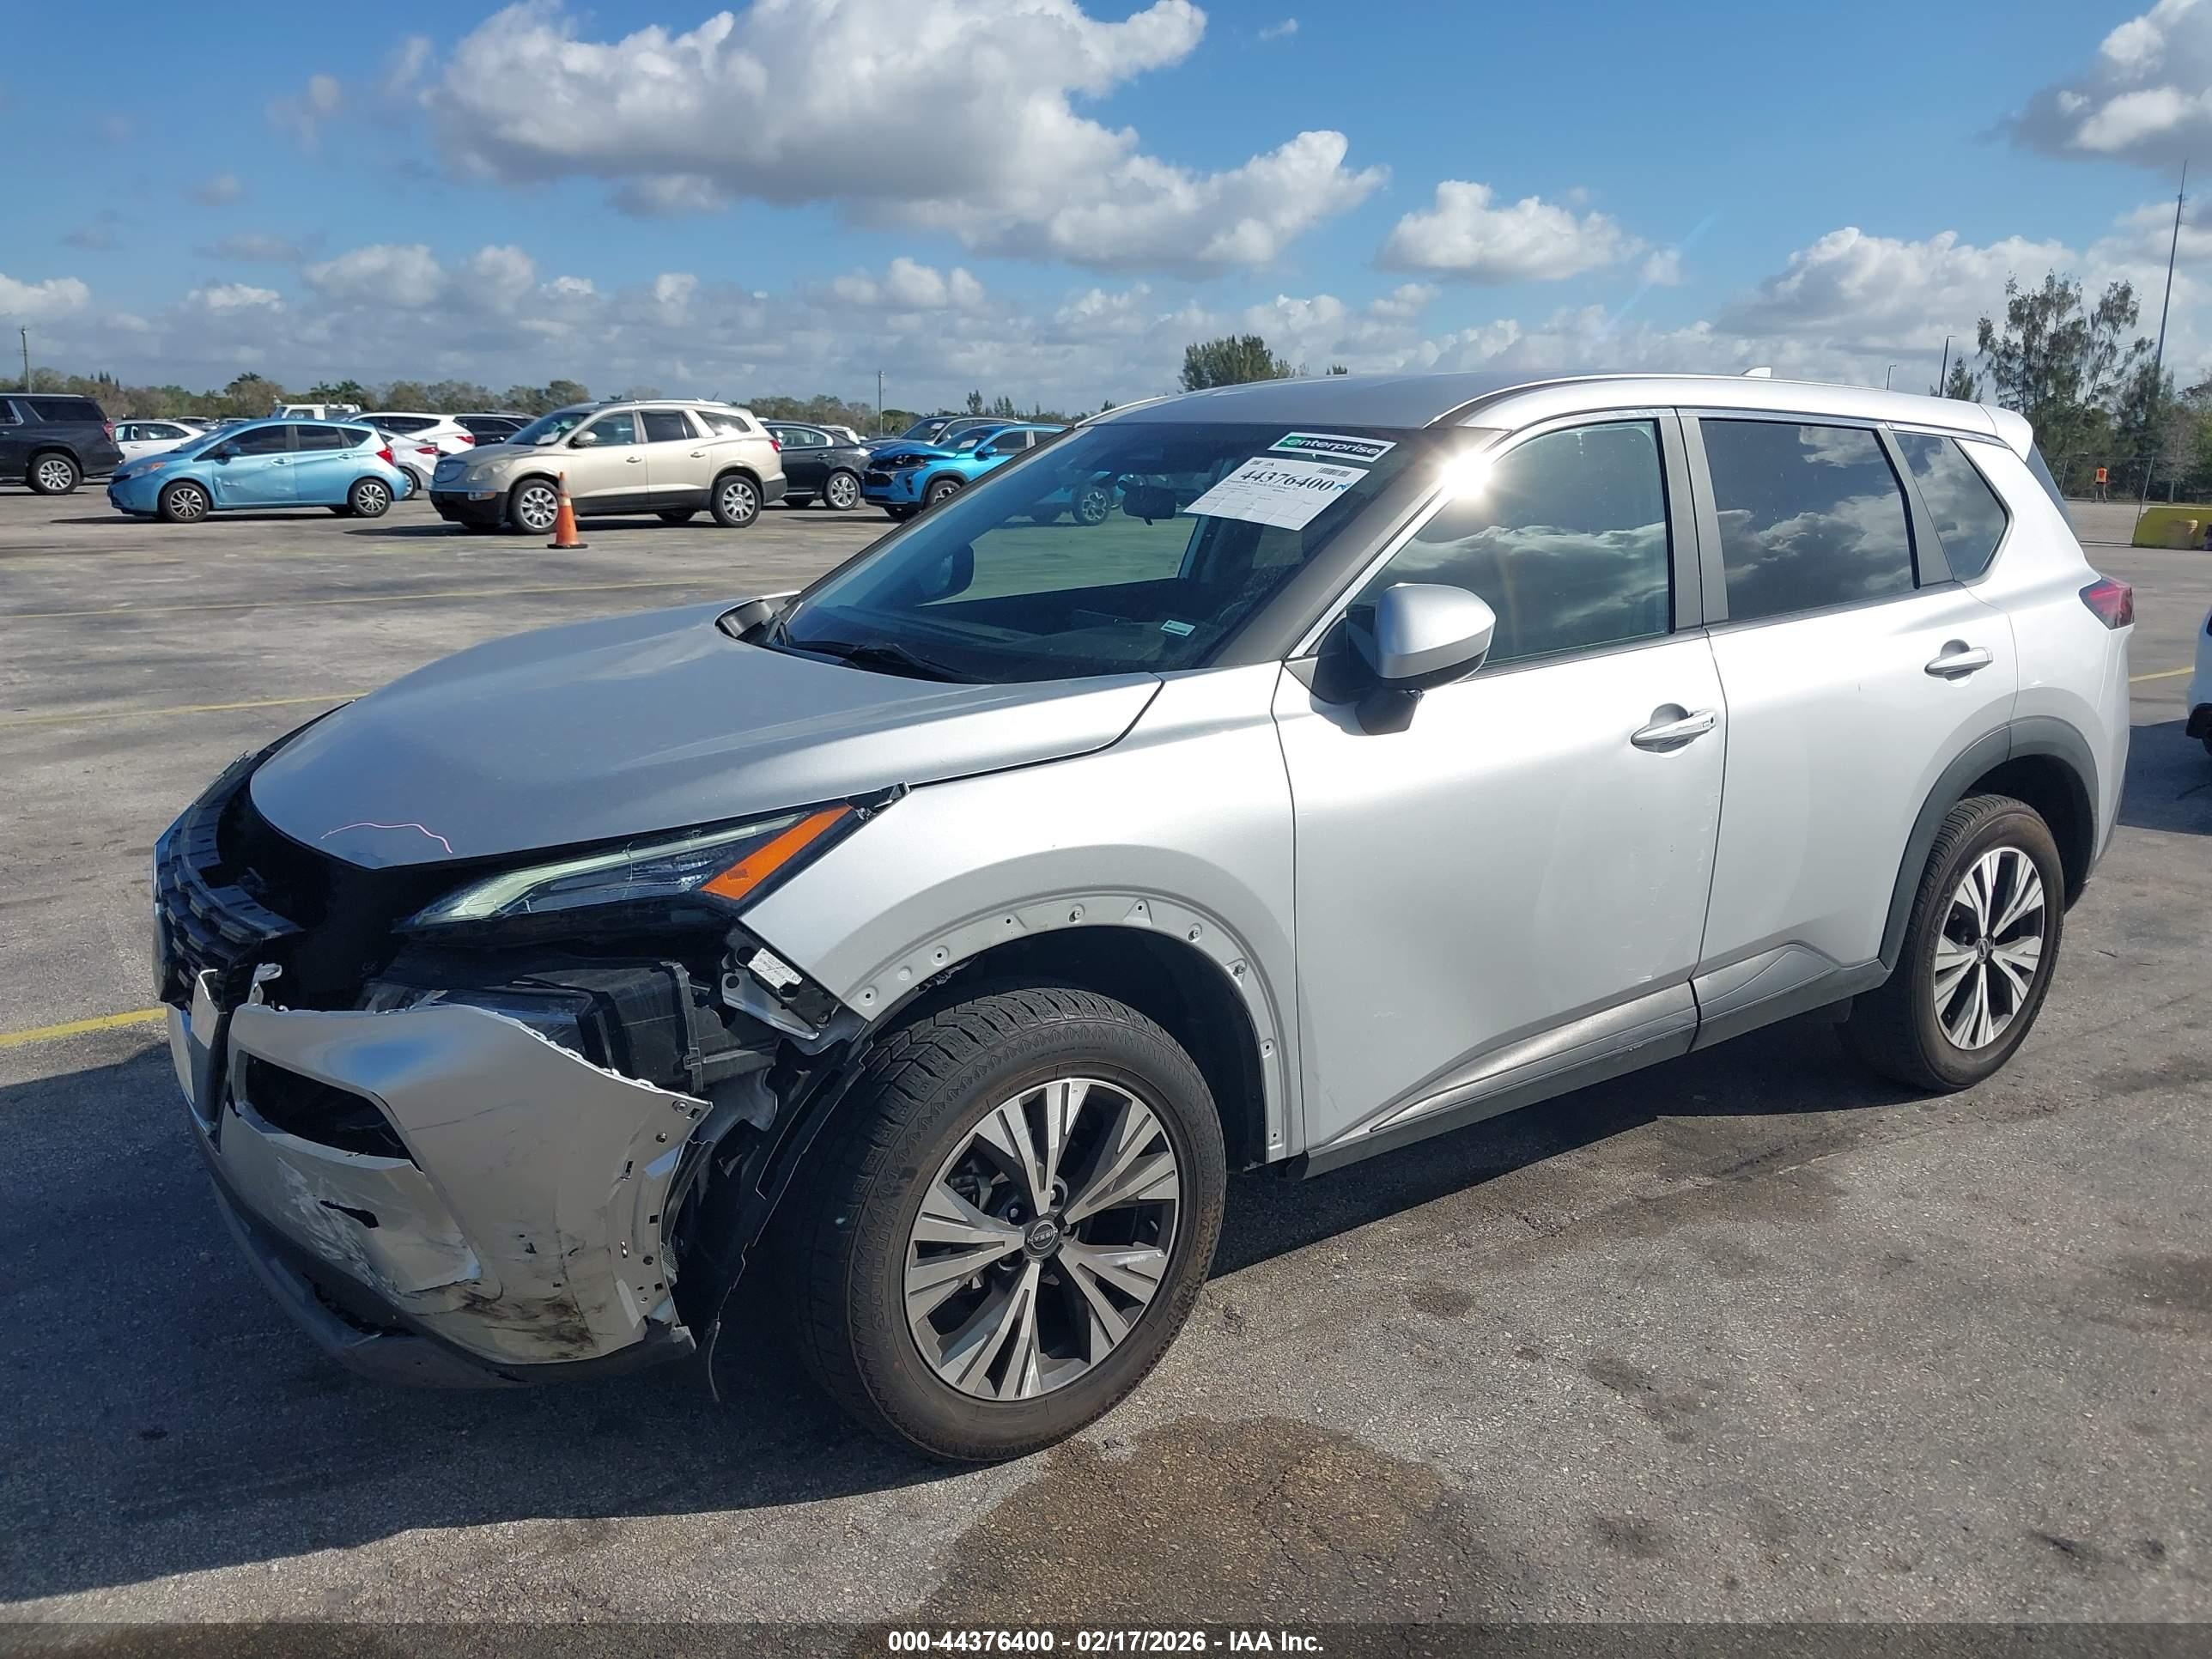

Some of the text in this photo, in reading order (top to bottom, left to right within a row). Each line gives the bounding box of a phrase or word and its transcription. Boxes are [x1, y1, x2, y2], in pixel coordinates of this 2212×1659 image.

[1285, 439, 1380, 453] enterprise
[1241, 470, 1335, 491] 44376400
[1027, 1228, 1059, 1244] NISSAN
